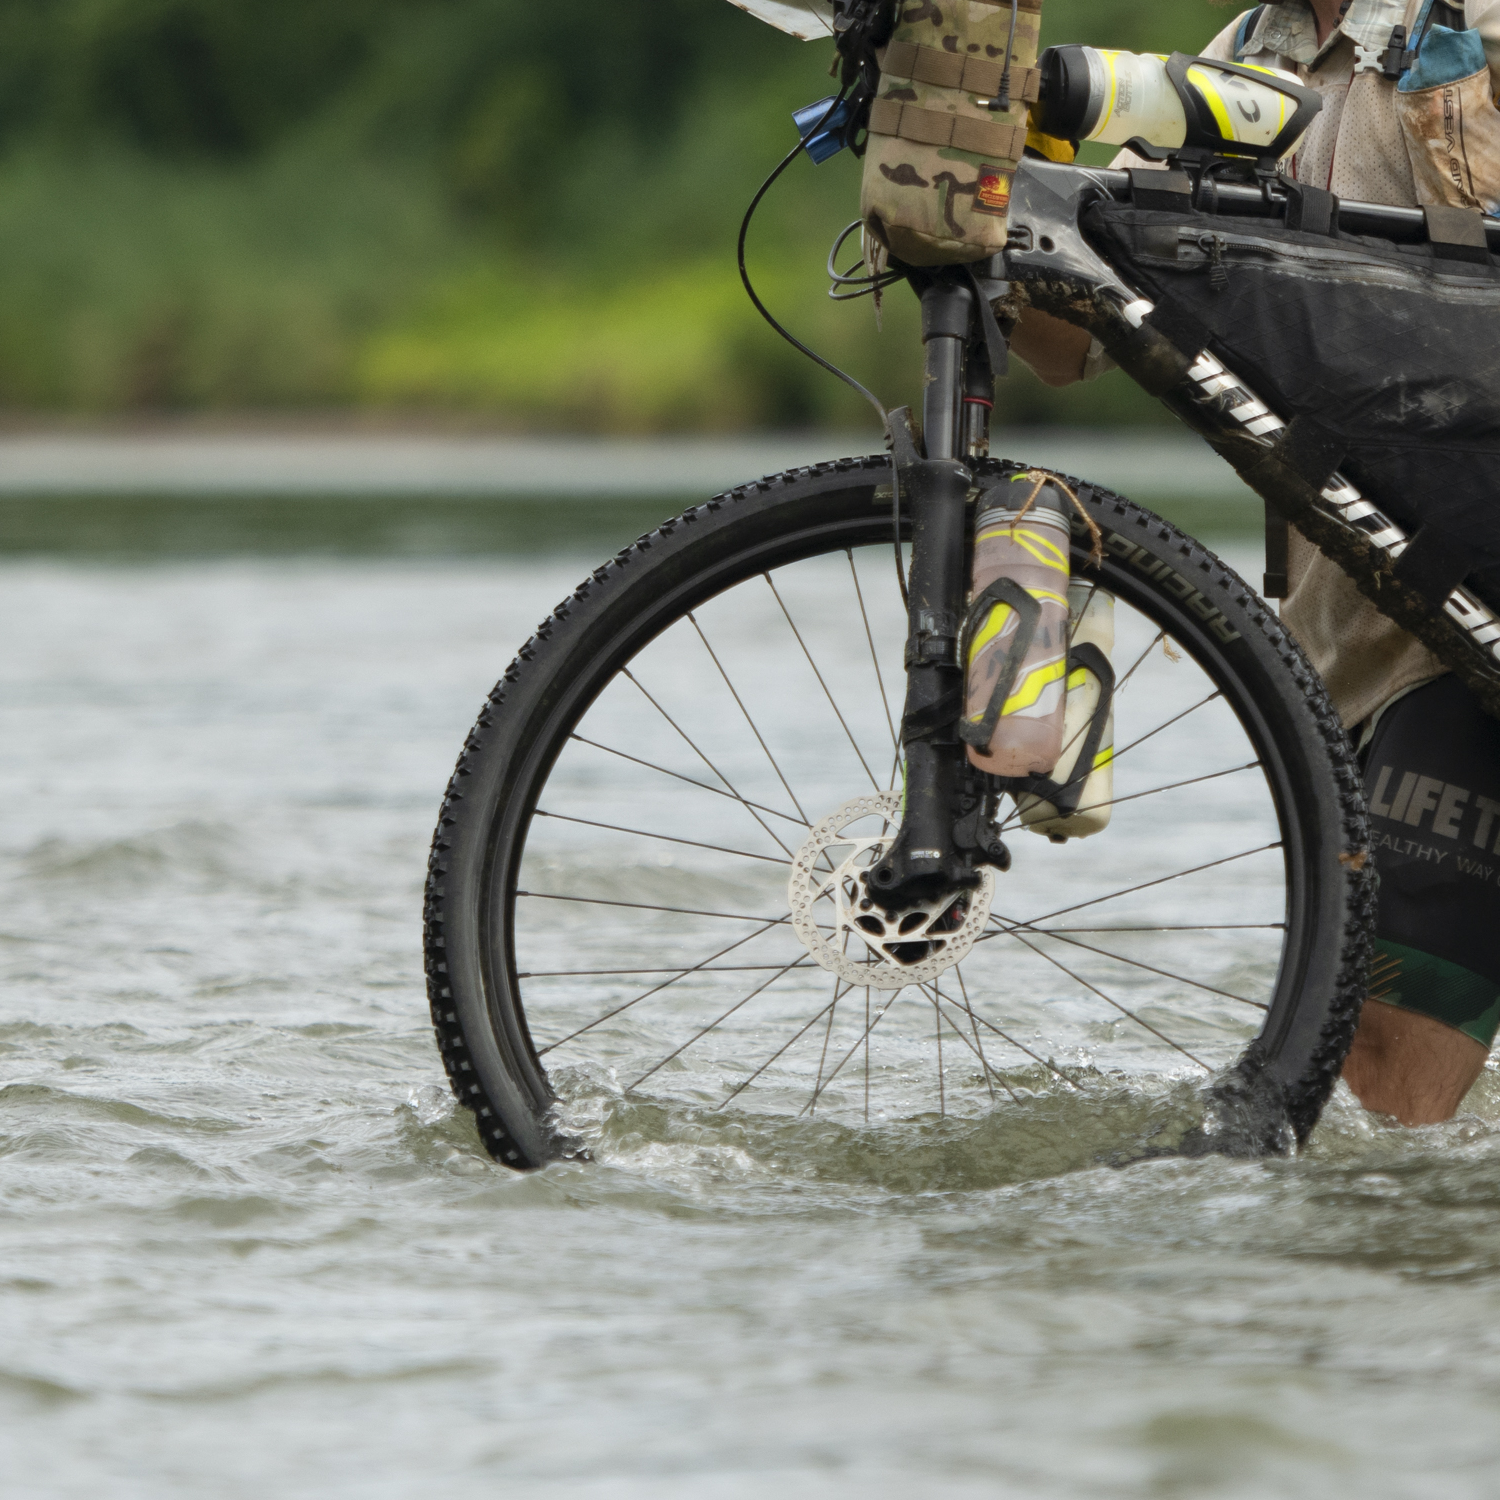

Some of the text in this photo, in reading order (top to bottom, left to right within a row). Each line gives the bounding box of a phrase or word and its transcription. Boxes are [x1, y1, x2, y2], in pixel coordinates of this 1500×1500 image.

[1443, 86, 1456, 154] VEST
[1104, 531, 1242, 645] RACING
[1368, 765, 1472, 840] LIFE
[1370, 829, 1449, 864] EALTHY
[1457, 855, 1494, 881] WAY
